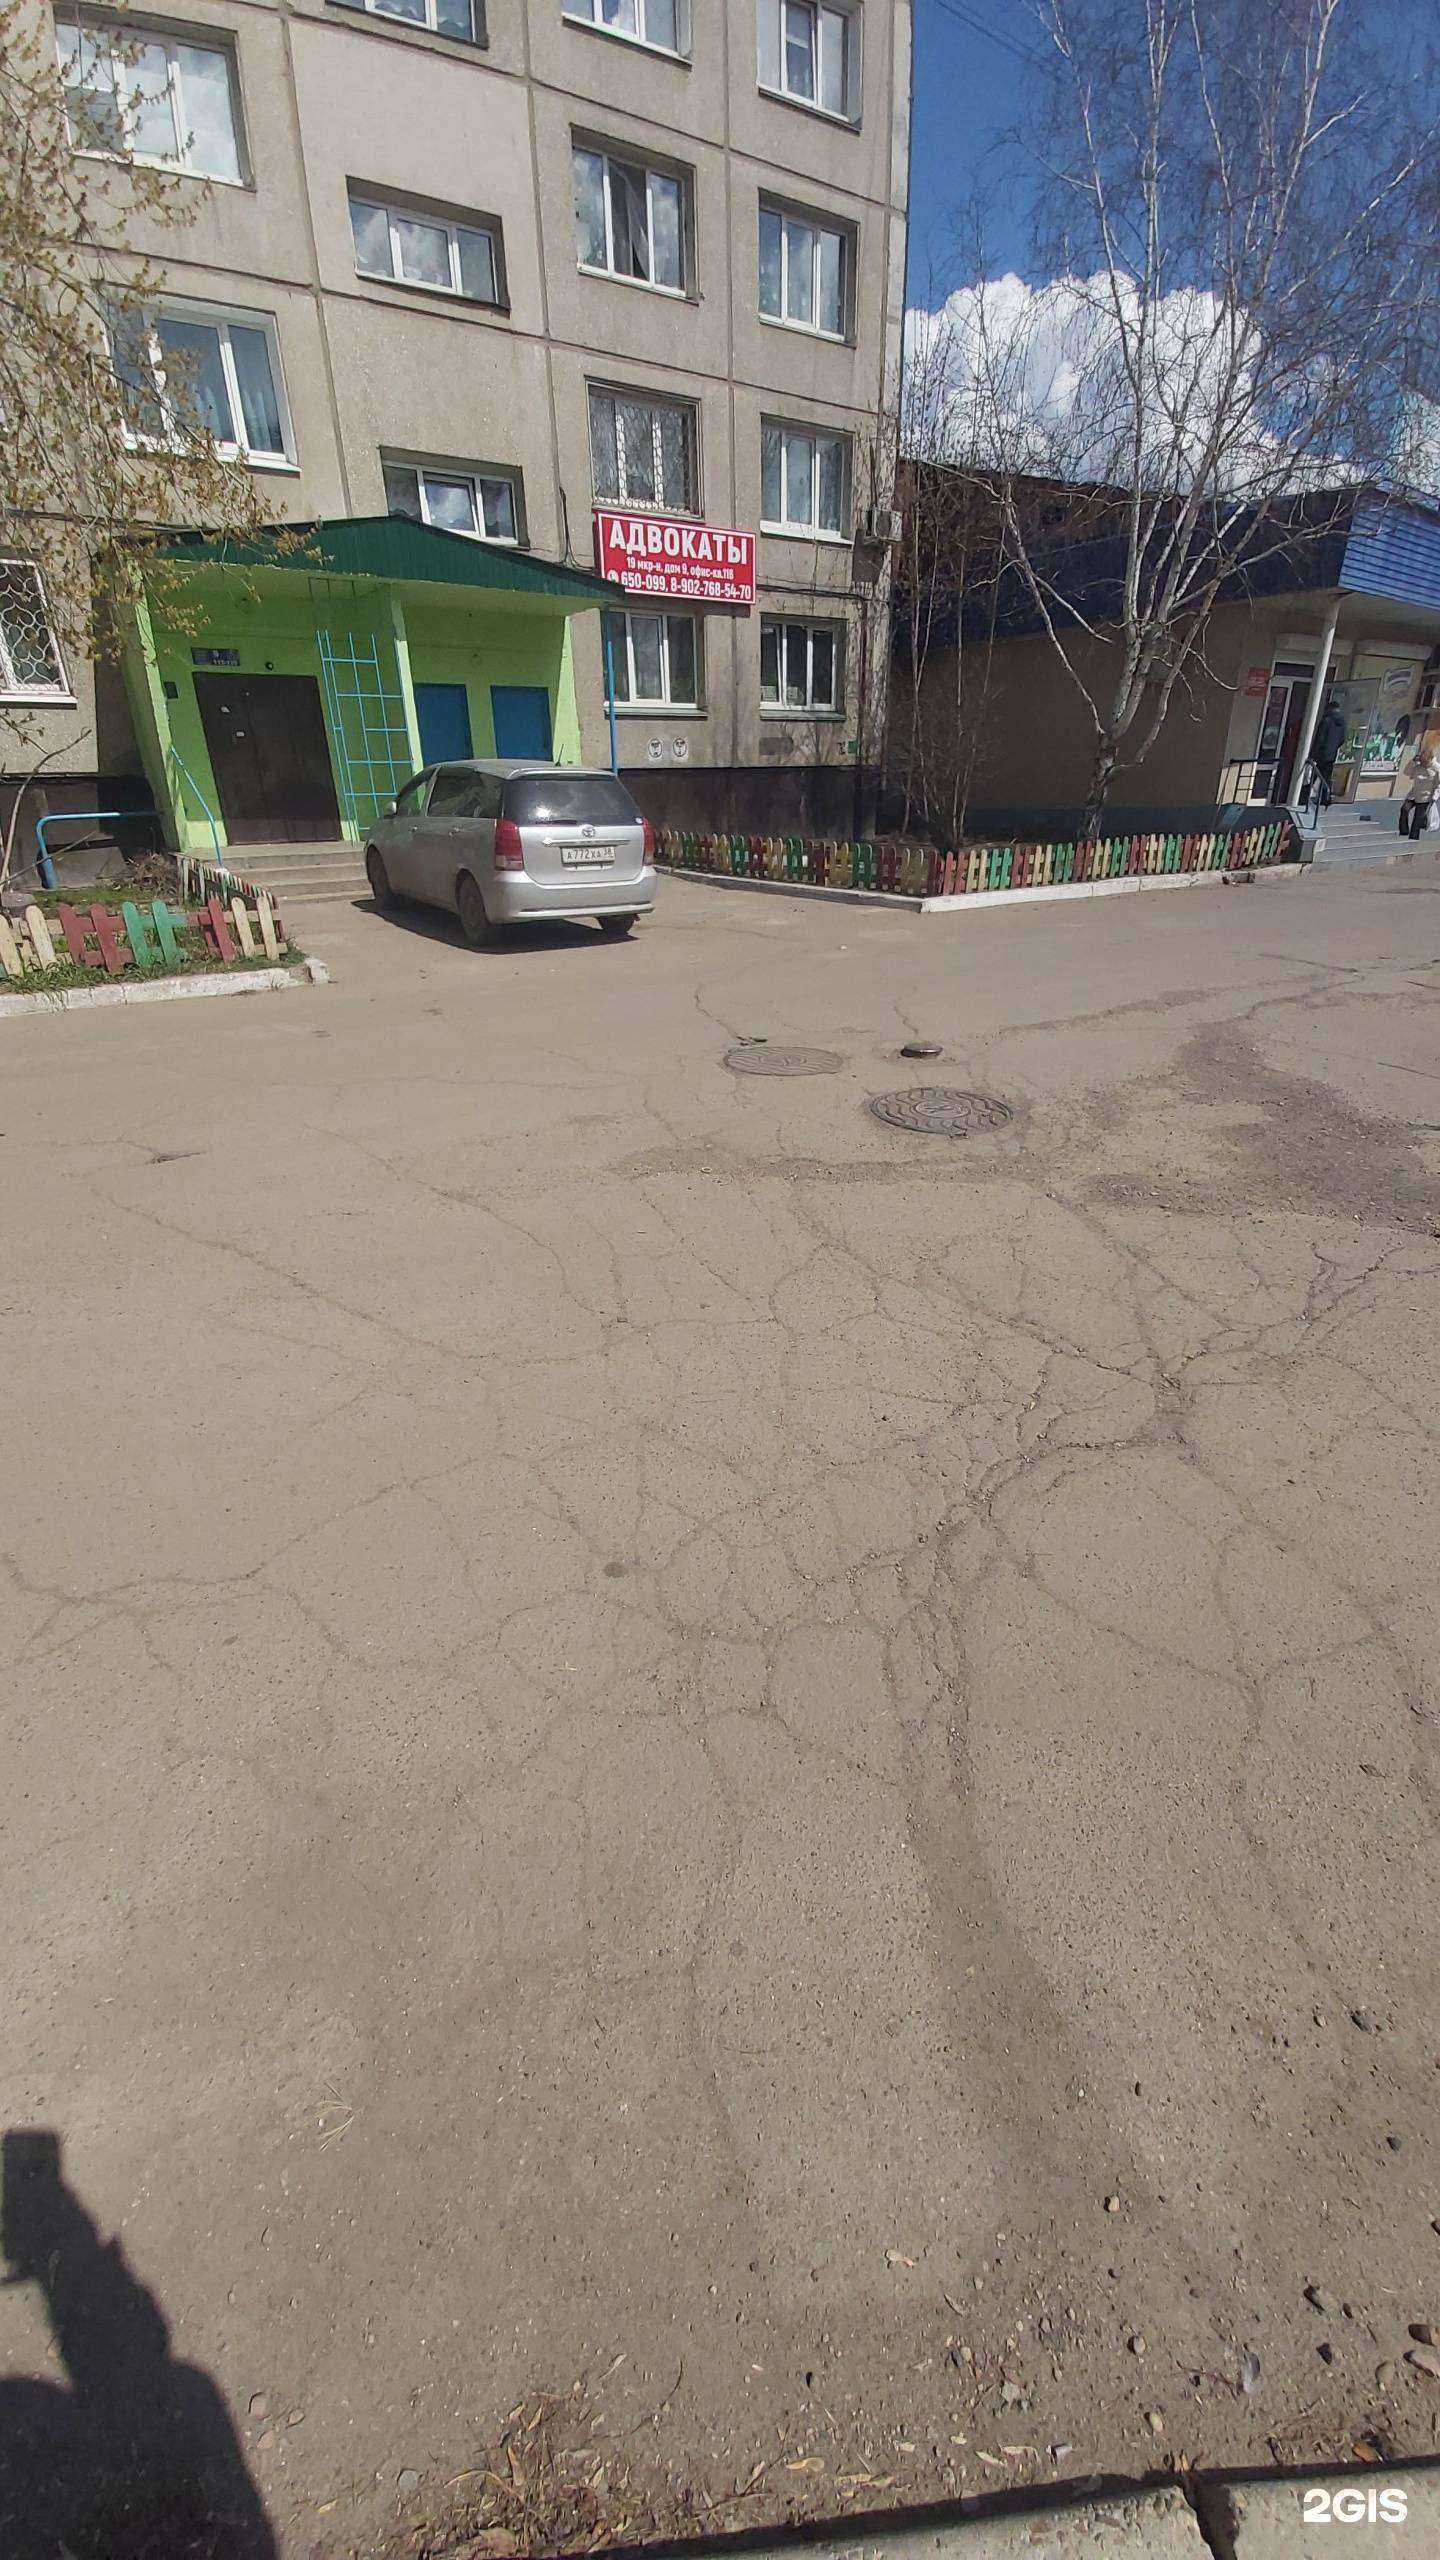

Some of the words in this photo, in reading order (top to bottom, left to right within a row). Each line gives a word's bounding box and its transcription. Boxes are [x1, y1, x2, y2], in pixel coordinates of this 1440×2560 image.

[609, 520, 747, 565] АДВОКАТЫ
[627, 557, 635, 569] 19
[664, 563, 681, 574] дом
[621, 571, 668, 592] 650-099,
[670, 577, 751, 599] 8-902-768-54-70
